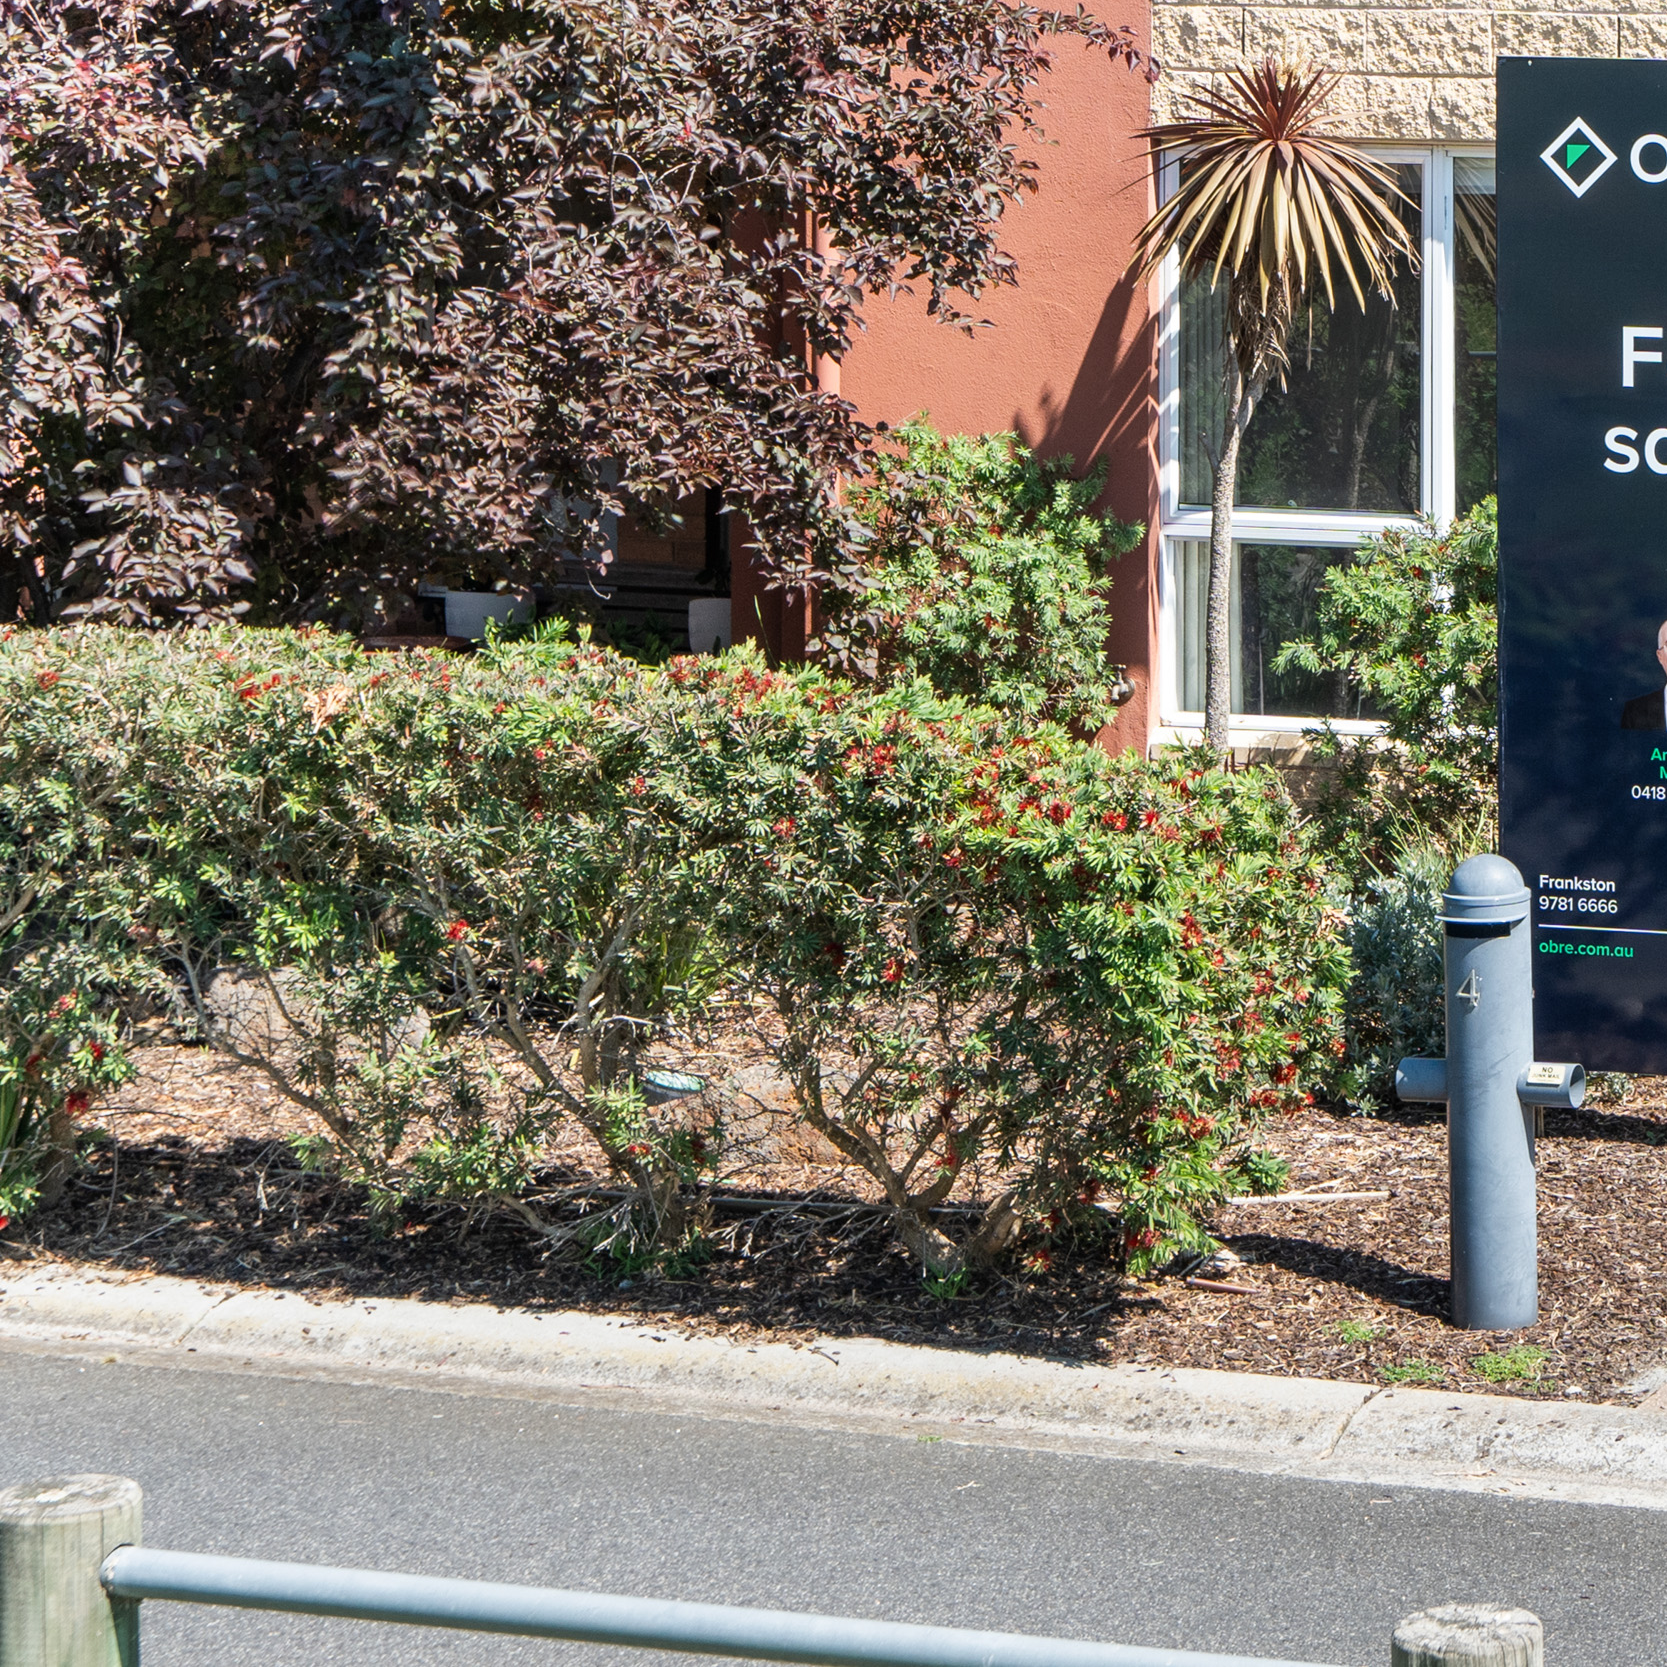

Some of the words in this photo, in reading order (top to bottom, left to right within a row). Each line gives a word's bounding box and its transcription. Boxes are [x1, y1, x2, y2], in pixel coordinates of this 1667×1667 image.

[1631, 785, 1666, 801] 0418
[1539, 874, 1616, 892] Frankston
[1539, 895, 1574, 911] 9781
[1577, 897, 1618, 914] 6666
[1539, 939, 1634, 958] obre.com.au
[1456, 968, 1480, 1007] 4
[1541, 1066, 1554, 1074] NO
